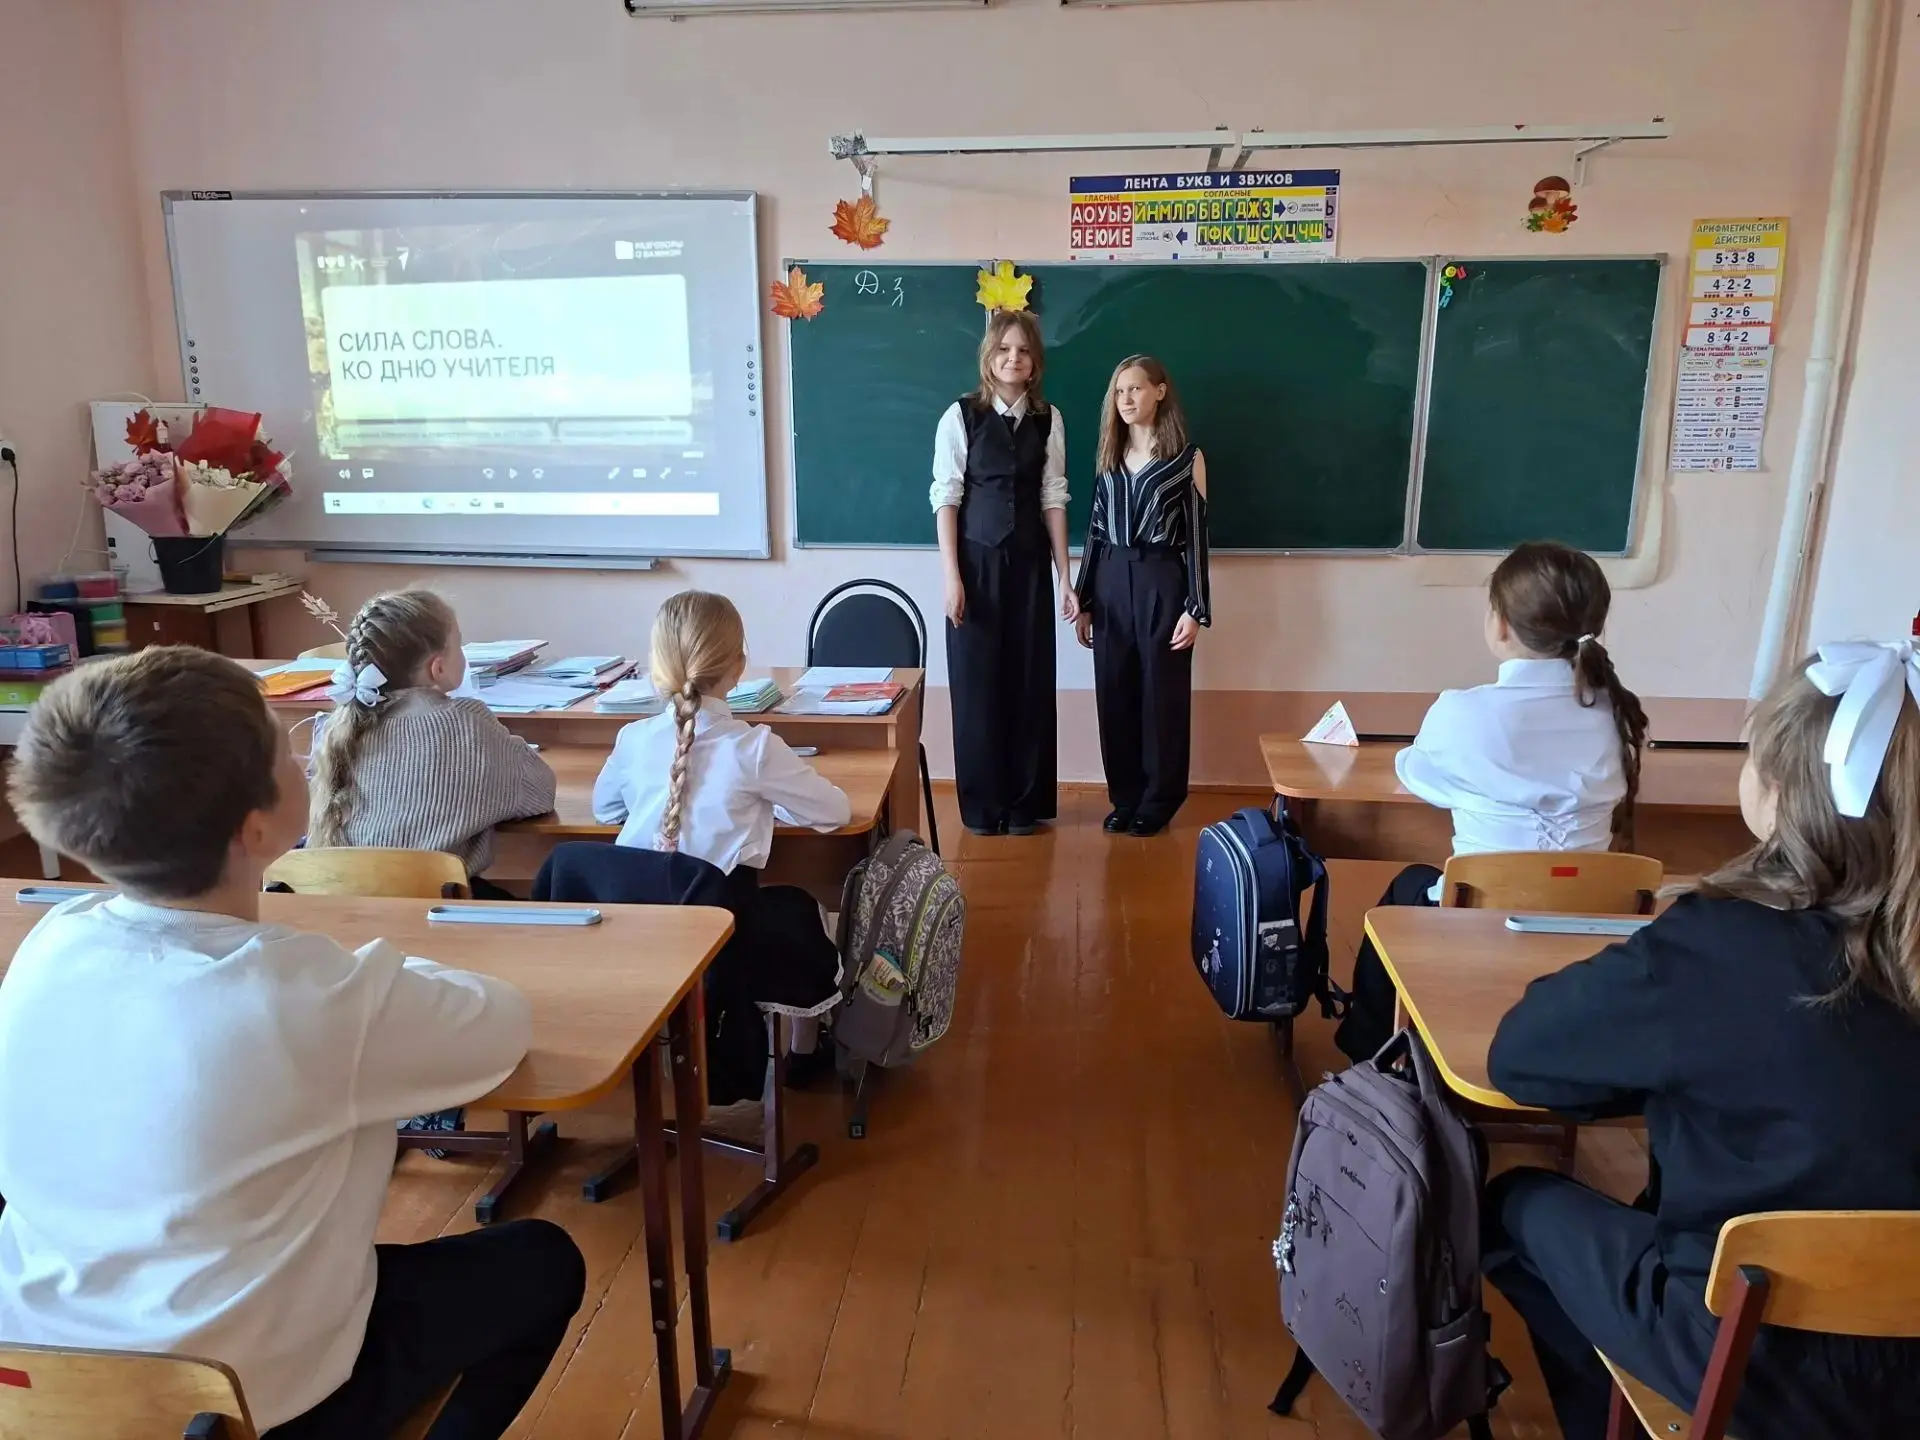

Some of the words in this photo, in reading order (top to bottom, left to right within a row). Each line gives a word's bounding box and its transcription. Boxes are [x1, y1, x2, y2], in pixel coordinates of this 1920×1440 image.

[1124, 177, 1169, 190] ЛЕНТА
[1177, 175, 1212, 188] БУКВ
[1220, 175, 1230, 186] И
[1238, 173, 1293, 186] ЗВУКОВ
[1084, 194, 1121, 202] ГЛАСНЫЕ
[1203, 189, 1252, 198] СОГЛАСНЫЕ
[1697, 222, 1781, 233] АРИФМЕТИЧЕСКИЕ
[1714, 234, 1761, 245] ДЕЙСТВИЯ
[338, 331, 406, 353] СИЛА
[412, 328, 503, 351] СЛОВА.
[342, 359, 373, 380] КО
[380, 358, 437, 383] ДНЮ
[443, 356, 556, 378] УЧИТЕЛЯ
